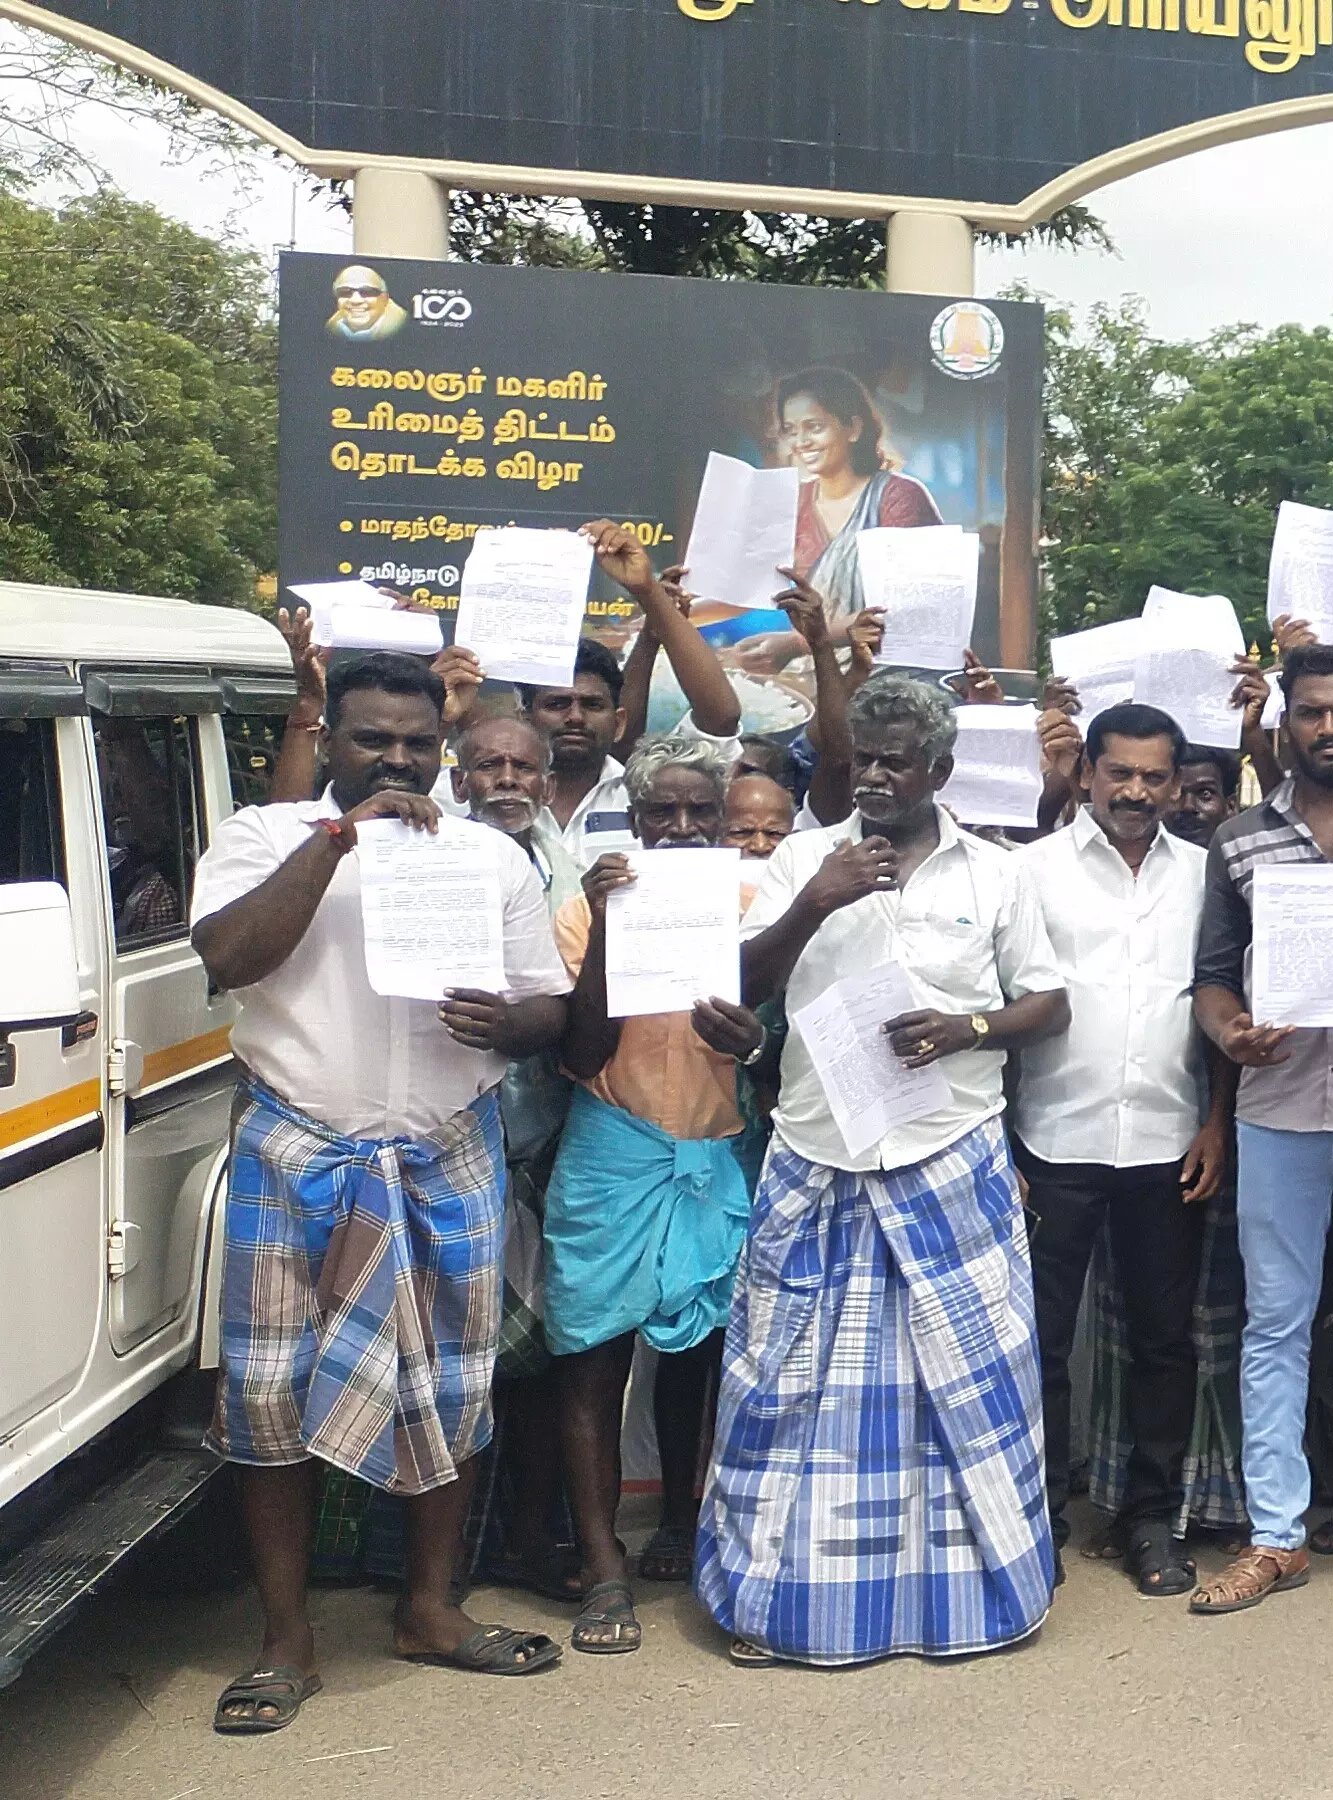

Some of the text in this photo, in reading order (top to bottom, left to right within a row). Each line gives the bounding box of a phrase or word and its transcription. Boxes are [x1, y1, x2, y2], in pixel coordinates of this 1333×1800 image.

[331, 366, 608, 402] கலைஞர் மகளிர்
[331, 401, 616, 446] உரிமைத் திட்டம்
[330, 441, 583, 491] தொடக்க விழா
[359, 562, 460, 587] தமிழ்நாடு
